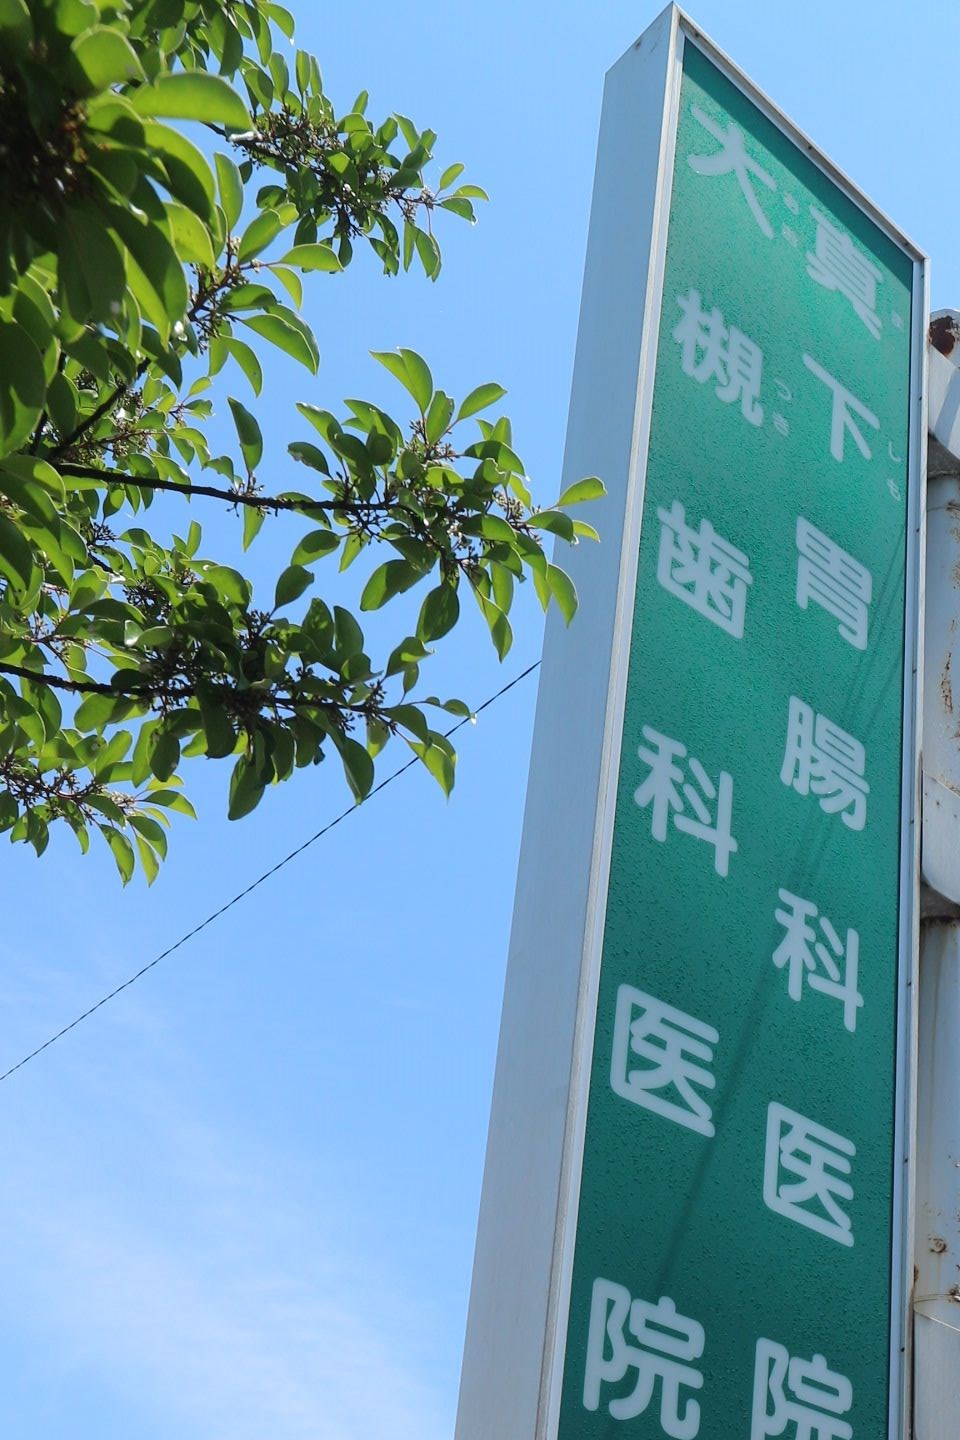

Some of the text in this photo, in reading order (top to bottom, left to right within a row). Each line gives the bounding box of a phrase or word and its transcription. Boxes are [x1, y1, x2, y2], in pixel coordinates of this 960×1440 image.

[583, 103, 777, 1440] 大槻歯科医院
